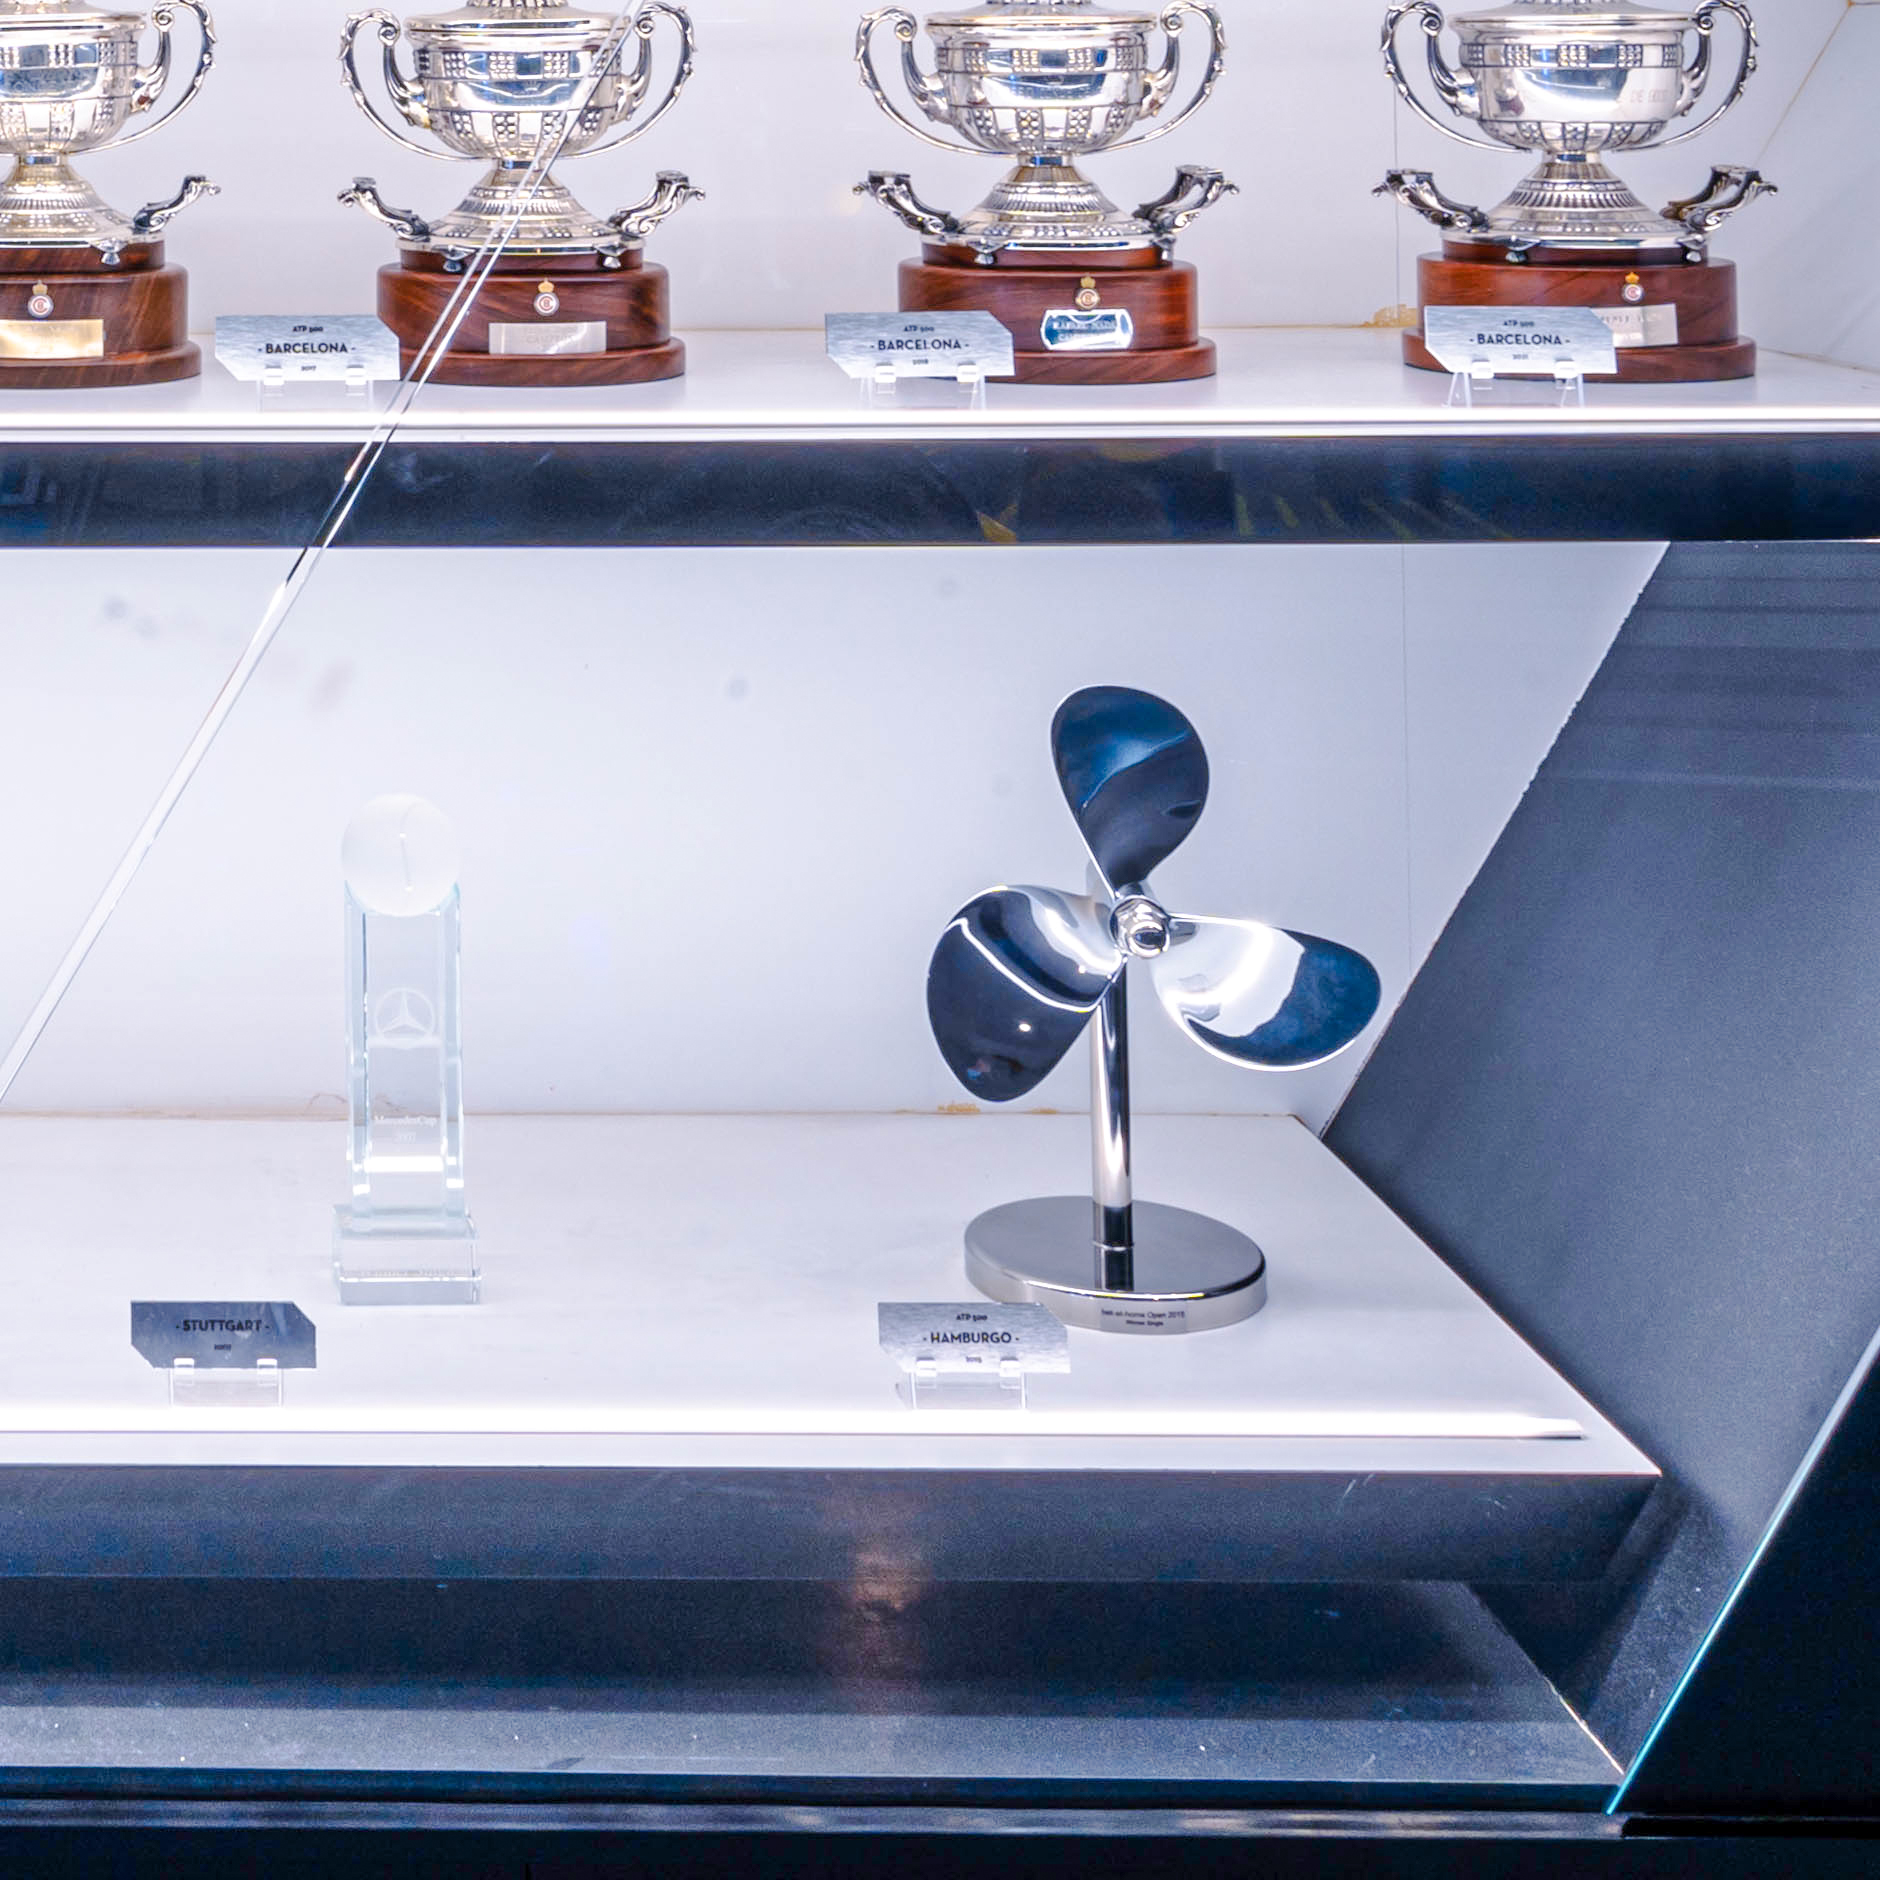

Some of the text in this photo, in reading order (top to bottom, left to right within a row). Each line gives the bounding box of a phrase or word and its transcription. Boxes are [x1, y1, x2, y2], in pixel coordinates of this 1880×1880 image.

[878, 339, 961, 351] BARCELONA
[1477, 334, 1562, 345] BARCELONA
[266, 343, 348, 354] BARCELONA
[183, 1319, 261, 1332] STUTTGART
[931, 1332, 1011, 1343] HAMBURGO
